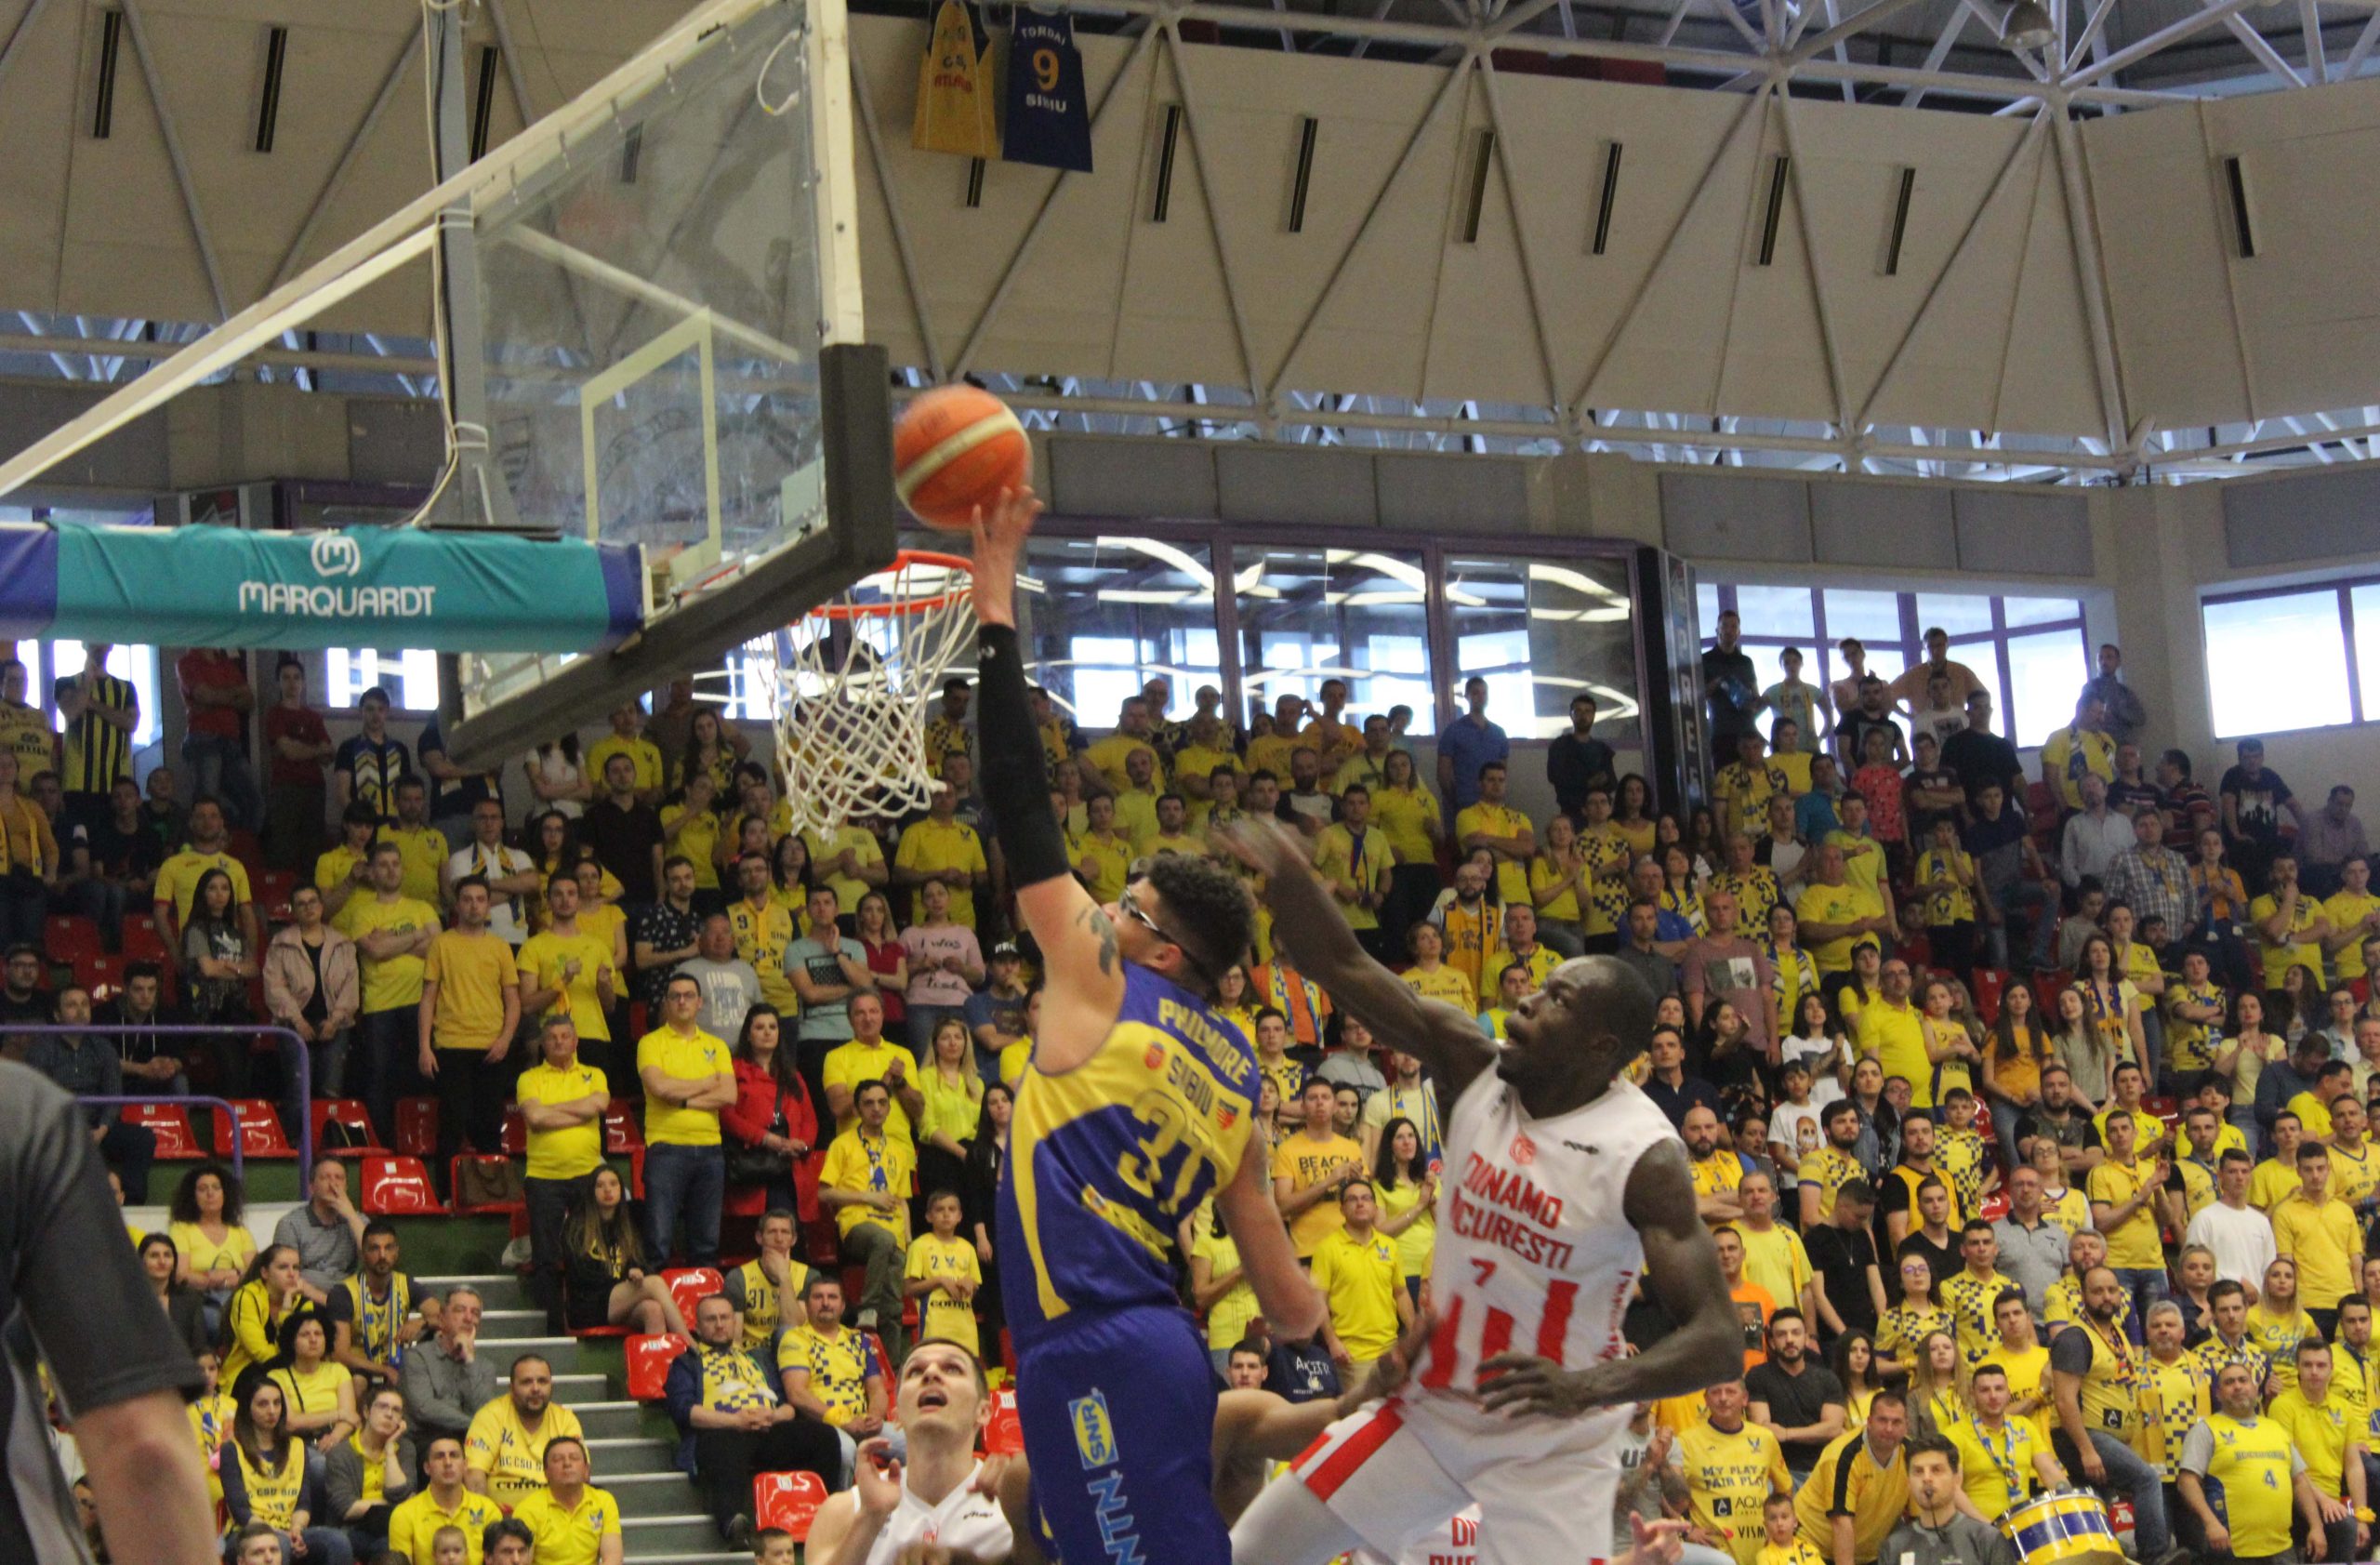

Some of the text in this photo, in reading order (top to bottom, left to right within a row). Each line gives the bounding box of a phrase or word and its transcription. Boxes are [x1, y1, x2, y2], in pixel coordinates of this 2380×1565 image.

[1032, 48, 1059, 91] 9
[239, 580, 435, 617] MARQUARDT
[1117, 1088, 1218, 1214] 31
[1450, 1187, 1573, 1270] CURESTI
[1470, 1257, 1497, 1287] 7
[747, 1288, 764, 1310] 31
[1082, 1403, 1106, 1462] SNR
[2265, 1469, 2278, 1489] 4
[1738, 1525, 1766, 1539] VISM
